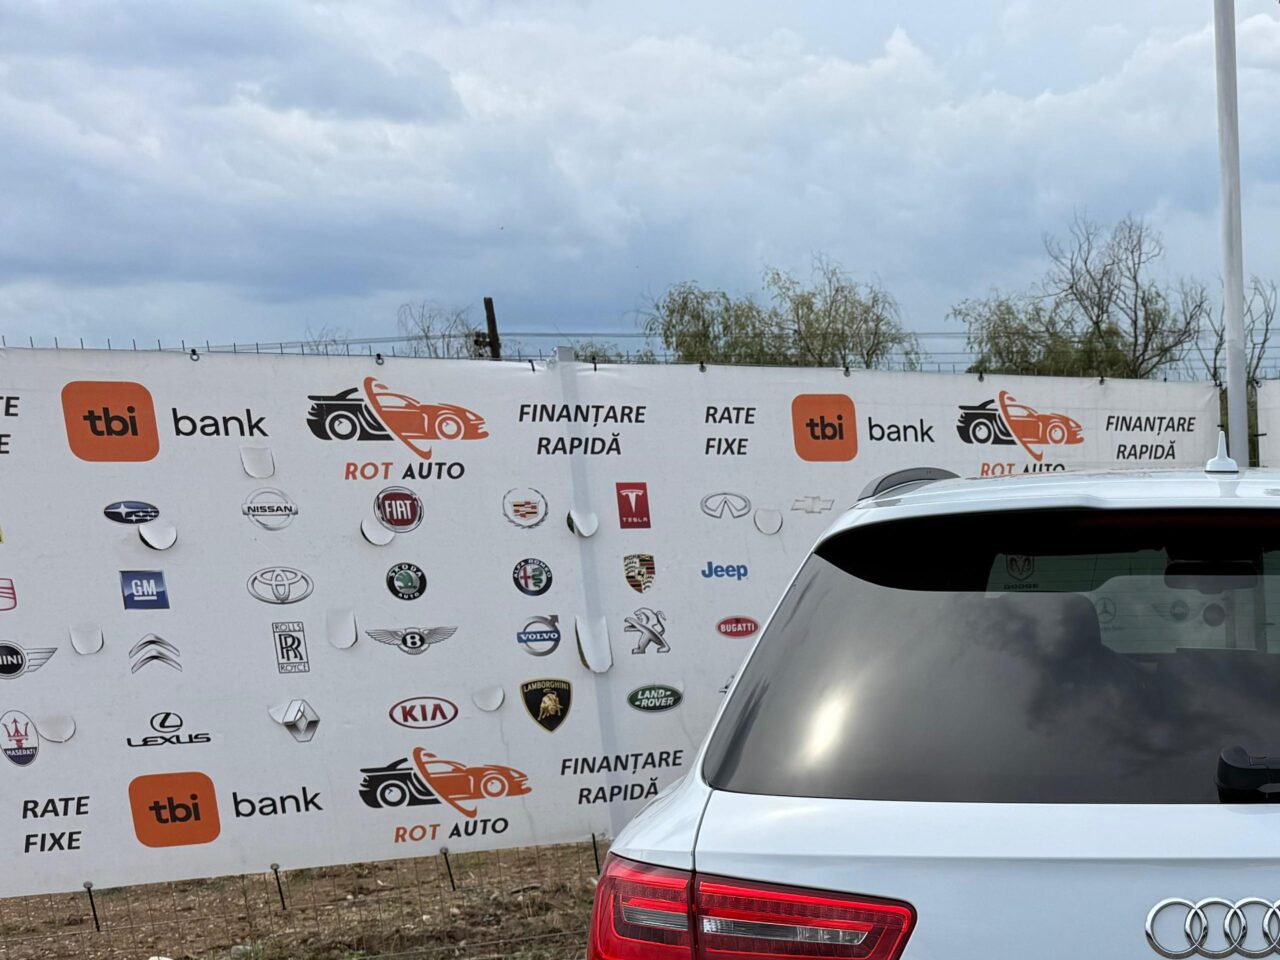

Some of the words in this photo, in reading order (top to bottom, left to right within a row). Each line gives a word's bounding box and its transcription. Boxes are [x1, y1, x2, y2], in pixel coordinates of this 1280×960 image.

[83, 406, 139, 438] tbi
[172, 408, 269, 437] bank
[518, 404, 646, 427] FINANȚARE
[704, 406, 756, 425] RATE
[1105, 415, 1196, 436] FINANȚARE
[805, 414, 844, 441] tbi
[868, 416, 935, 443] bank
[536, 432, 622, 455] RAPIDĂ
[704, 437, 748, 456] FIXE
[1116, 440, 1176, 460] RAPIDĂ
[344, 463, 393, 481] ROT
[402, 462, 465, 480] AUTO
[981, 463, 1016, 476] ROT
[247, 505, 293, 513] NISSAN
[384, 500, 412, 520] FIAT
[701, 561, 748, 581] Jeep
[131, 579, 157, 595] GM
[275, 623, 303, 632] ROLLS
[520, 632, 558, 640] VOLVO
[720, 623, 755, 633] BUGATTI
[280, 663, 308, 672] ROYCE
[523, 681, 569, 692] LAMBORGHINI
[401, 703, 448, 723] KIA
[127, 733, 211, 748] LEXUS
[6, 748, 36, 757] MASERATI
[561, 749, 684, 776] FINANȚARE
[578, 776, 659, 805] RAPIDĂ
[21, 796, 90, 819] RATE
[149, 794, 201, 824] tbi
[233, 786, 324, 818] bank
[394, 823, 440, 843] ROT
[448, 817, 508, 839] AUTO
[24, 831, 82, 853] FIXE
